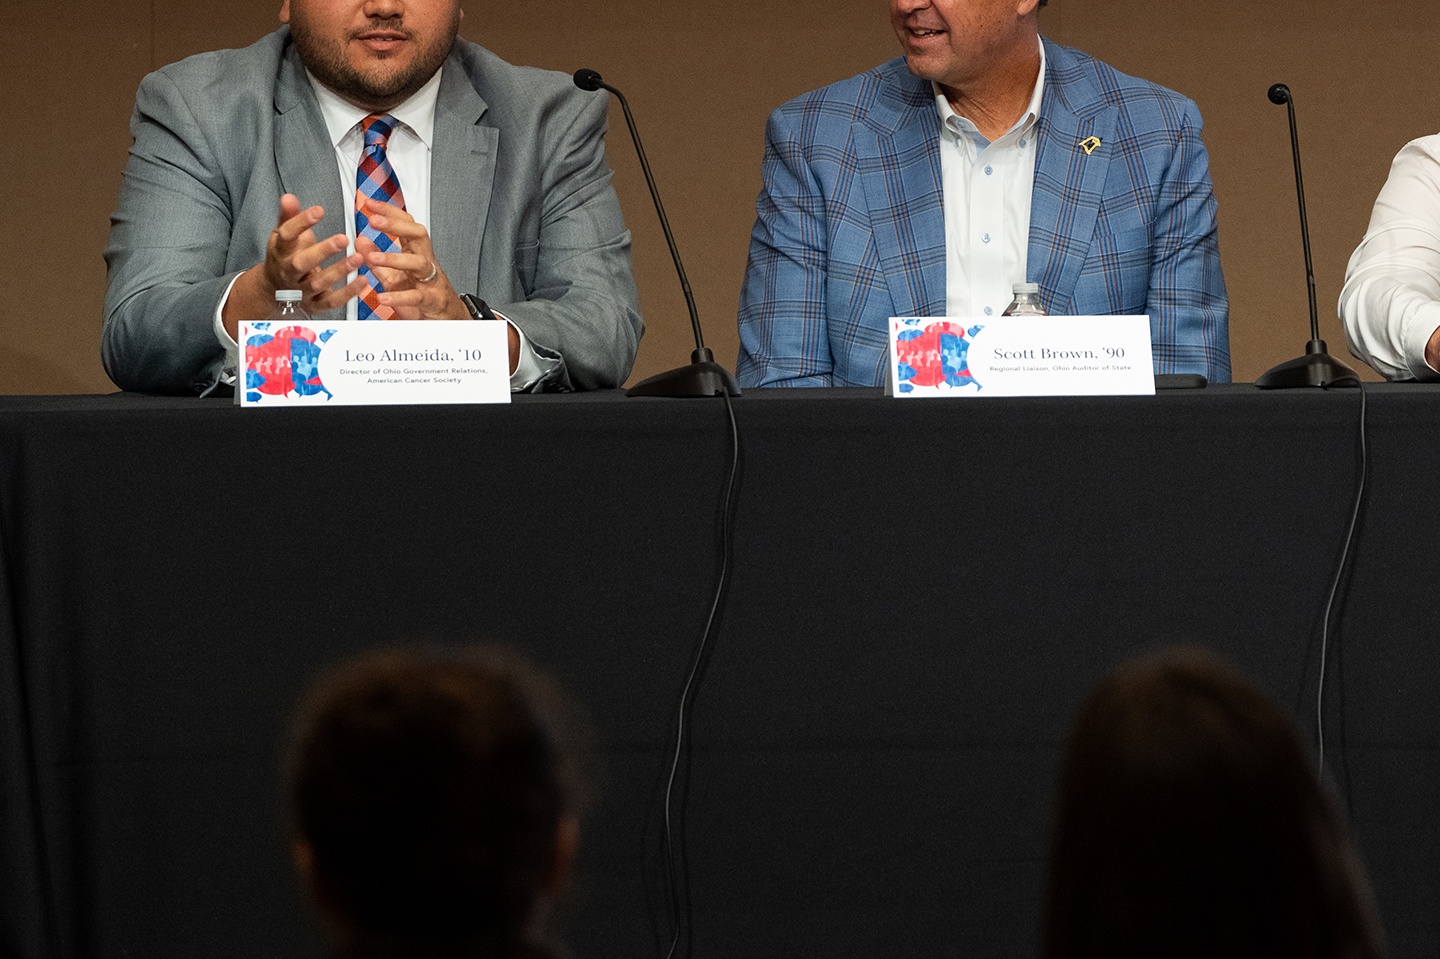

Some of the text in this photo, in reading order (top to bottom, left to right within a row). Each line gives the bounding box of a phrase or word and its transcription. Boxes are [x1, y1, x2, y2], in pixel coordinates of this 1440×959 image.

[345, 349, 375, 362] Leo
[379, 348, 455, 363] Almeida,
[994, 347, 1036, 360] Scott
[1041, 347, 1098, 360] Brown,
[451, 367, 488, 375] Relations,
[989, 365, 1021, 373] Regional
[433, 377, 462, 385] Society
